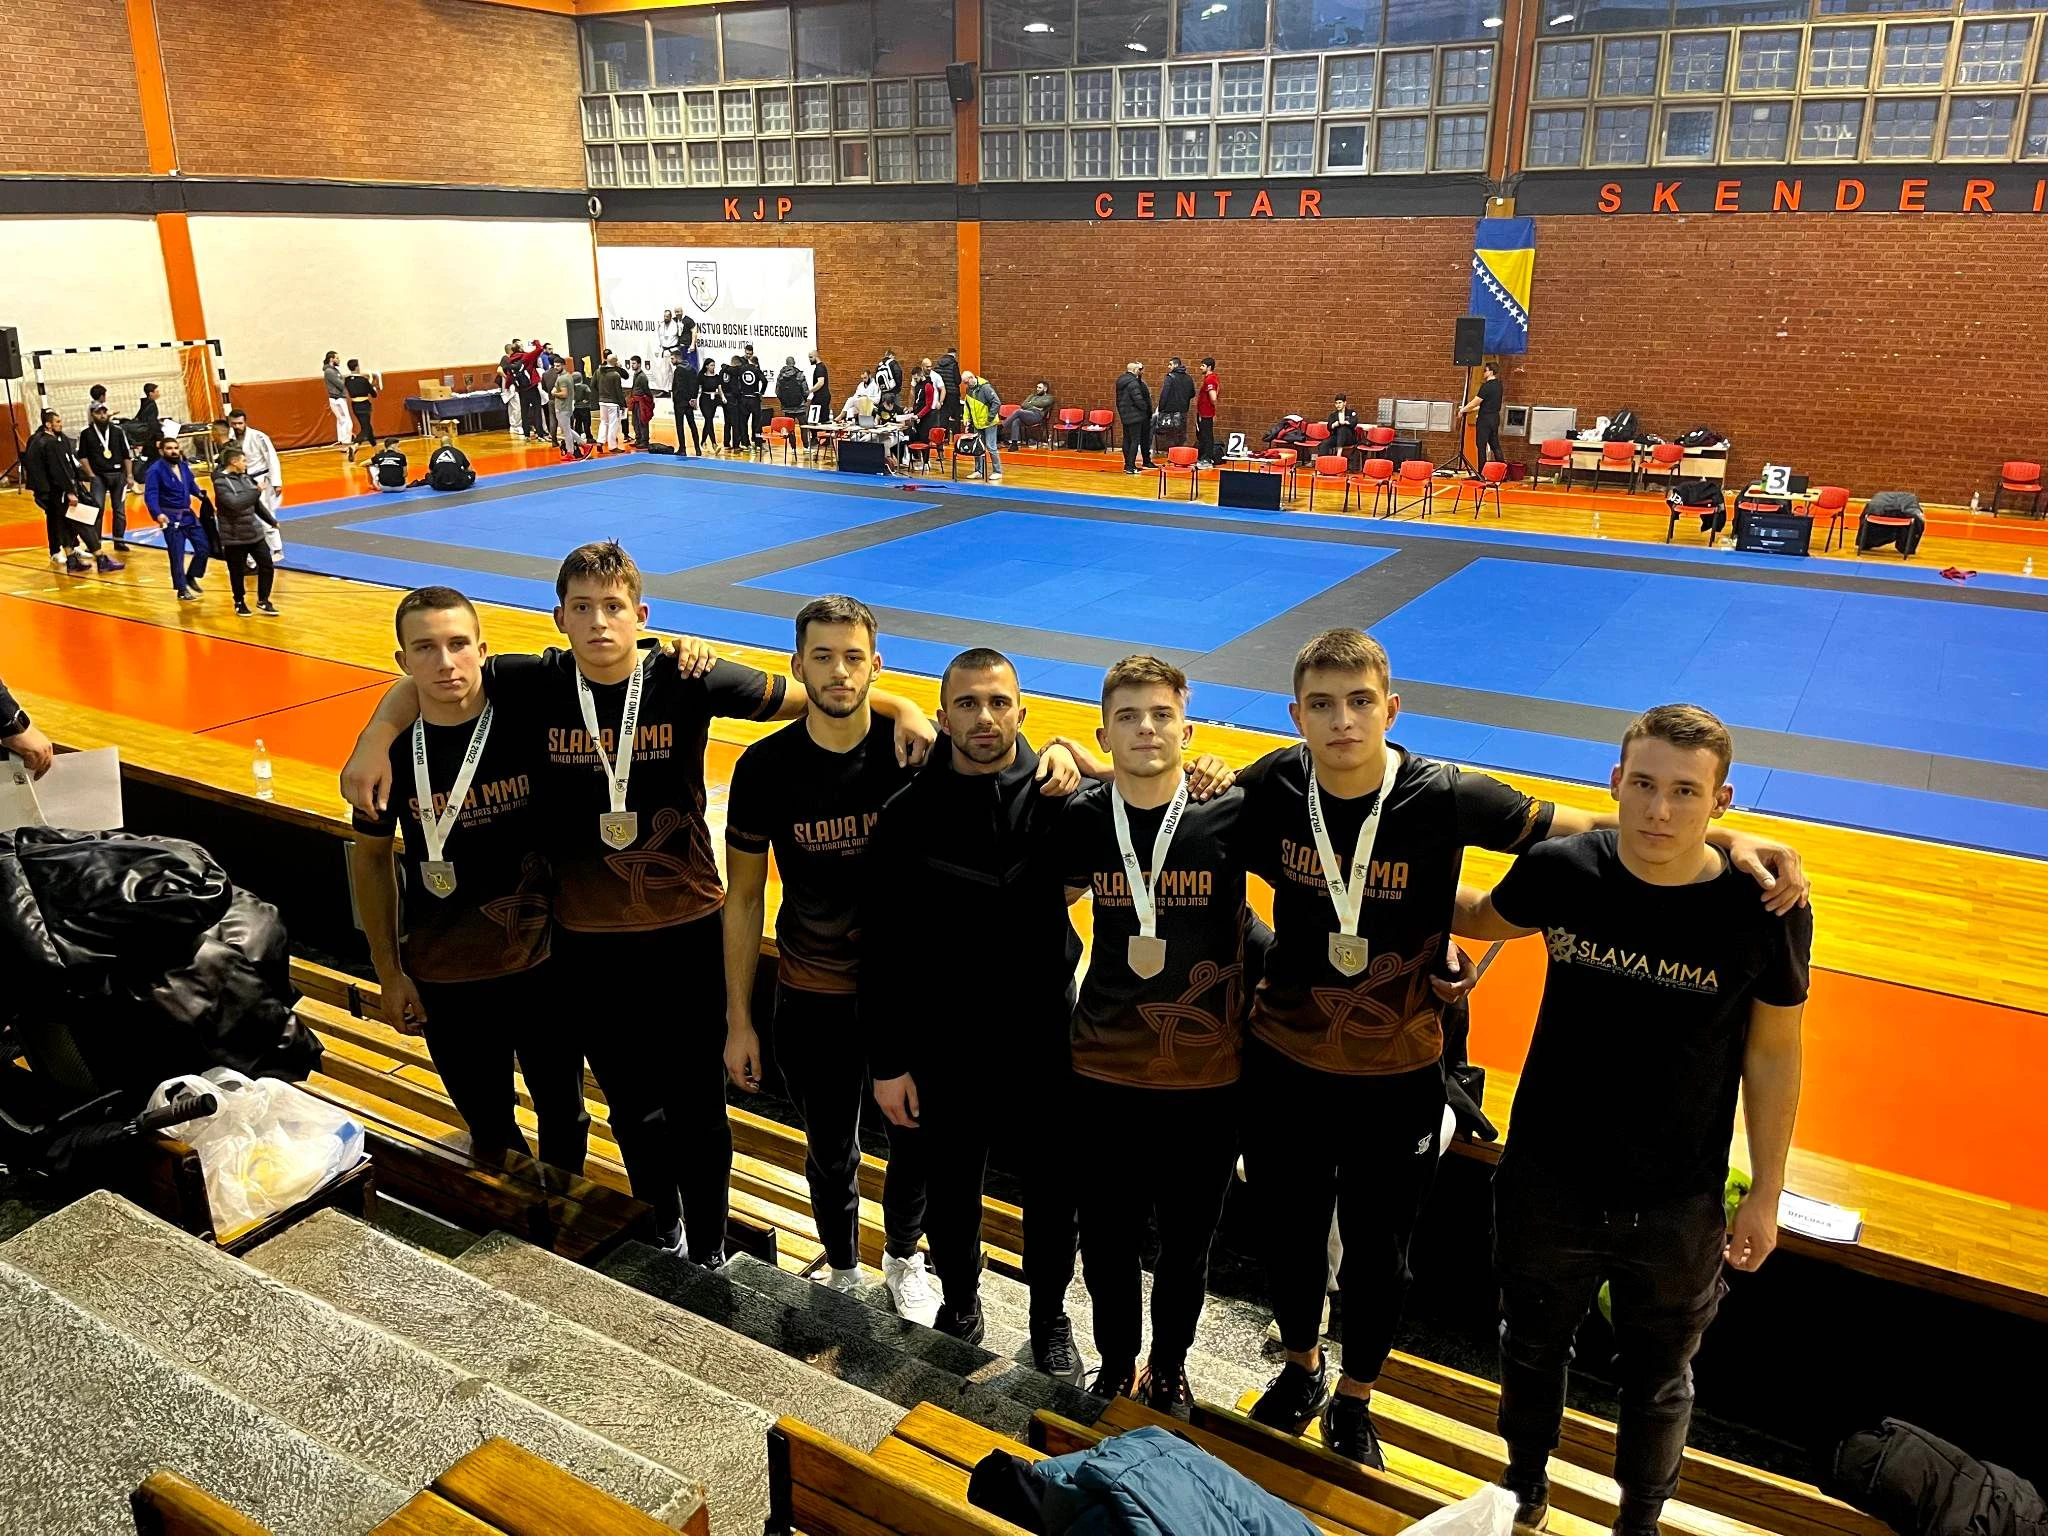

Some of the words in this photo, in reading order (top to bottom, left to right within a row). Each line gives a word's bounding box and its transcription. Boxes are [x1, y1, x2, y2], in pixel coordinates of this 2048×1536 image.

[724, 197, 792, 220] KJP
[1095, 190, 1322, 218] CENTAR
[1578, 179, 2048, 212] SKENDERI
[610, 317, 644, 332] DRŽAVNO
[645, 320, 656, 332] JIU
[697, 322, 721, 335] NSTVO
[723, 323, 748, 336] BOSNE
[754, 325, 808, 338] HERCEGOVINE
[697, 339, 727, 349] BRAZILIAN
[728, 340, 737, 349] JIU
[1230, 435, 1242, 453] 2
[1768, 468, 1787, 490] 3
[630, 689, 639, 700] JIU
[624, 700, 638, 736] DRŽAVNO
[415, 731, 425, 766] DRŽAVNO
[633, 723, 673, 751] MA
[465, 745, 479, 764] 2022
[636, 751, 648, 761] JIU
[650, 749, 670, 760] JITSU
[481, 774, 530, 806] MMA
[1164, 801, 1183, 835] DRŽAVNO
[1179, 789, 1187, 801] JIU
[793, 815, 858, 844] SLAVA
[1093, 871, 1152, 897] SLAA
[1161, 870, 1212, 896] MMA
[1369, 859, 1409, 889] MA
[1167, 897, 1174, 907] &
[1175, 897, 1187, 907] JIU
[1188, 897, 1208, 906] JITSU
[1377, 889, 1402, 900] JITSU
[1577, 940, 1650, 974] SLAVA
[1657, 959, 1719, 988] MMA
